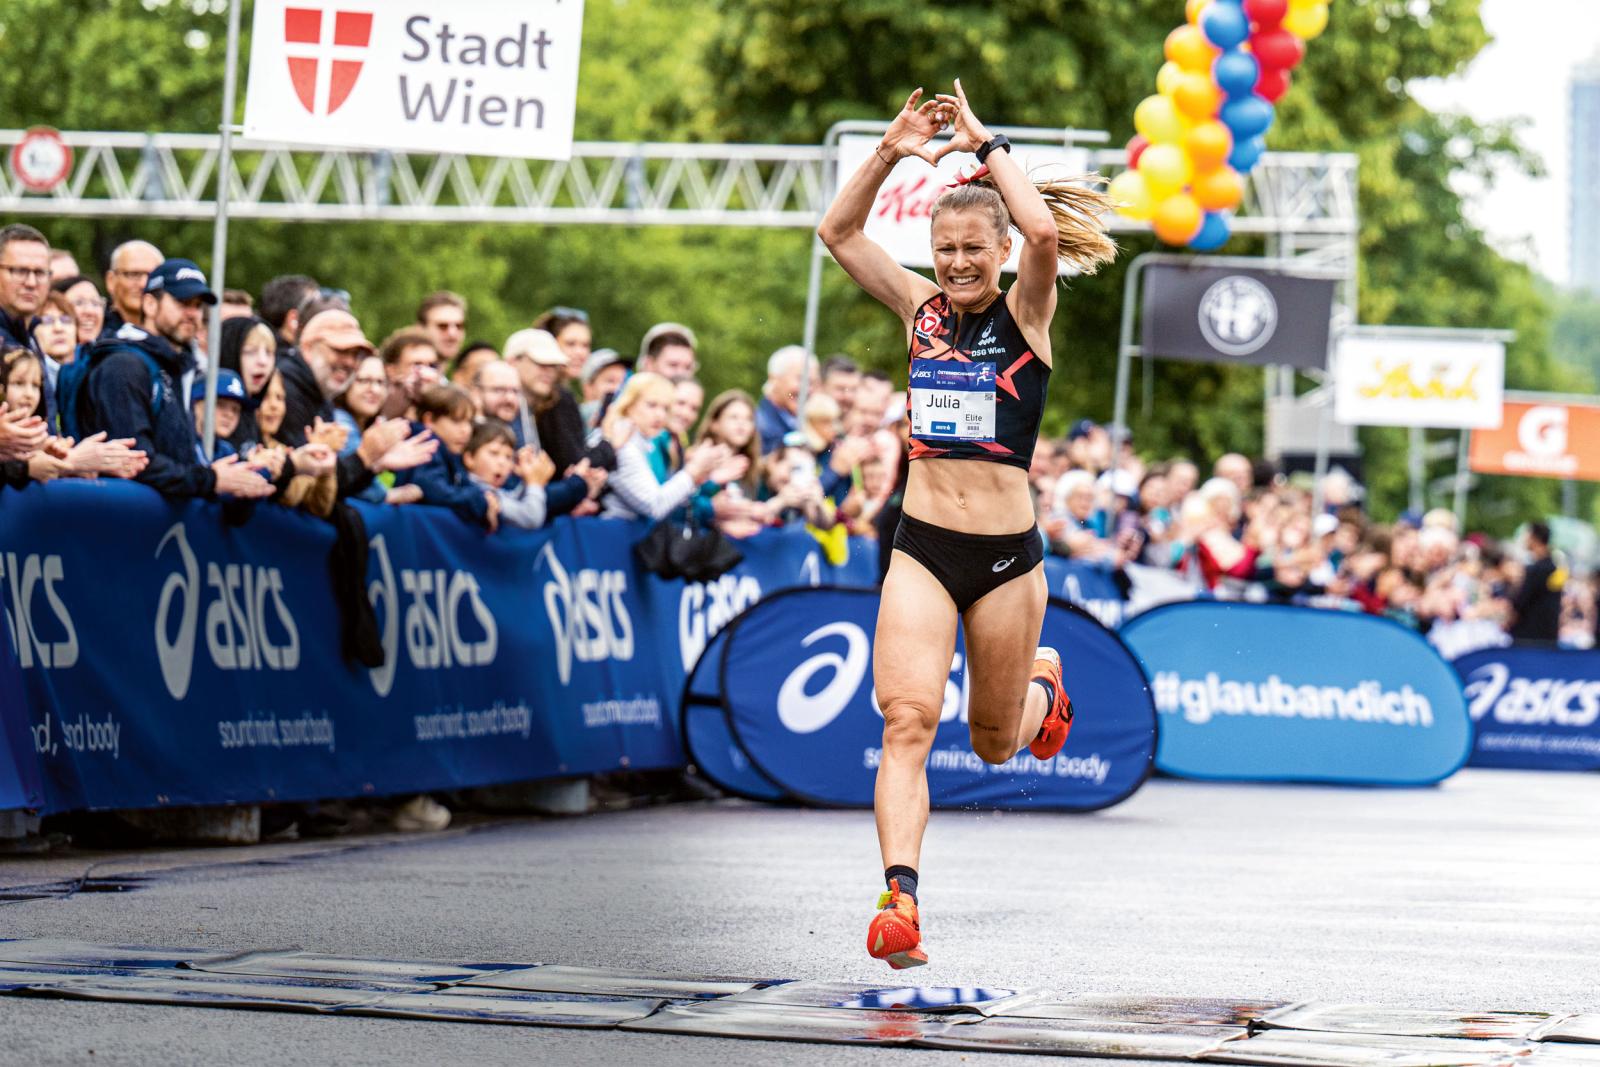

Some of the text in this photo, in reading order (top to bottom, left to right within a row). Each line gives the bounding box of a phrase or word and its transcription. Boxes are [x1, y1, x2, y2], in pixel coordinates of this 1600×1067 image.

[402, 15, 552, 69] Stadt
[399, 75, 544, 129] Wien
[972, 346, 1006, 357] DSG Wien
[926, 394, 960, 409] Julia
[965, 413, 983, 422] Elite
[1517, 406, 1569, 455] G
[205, 561, 301, 670] asics
[1151, 671, 1434, 727] #glaubandich
[1494, 677, 1600, 727] asics
[85, 712, 121, 760] body
[1055, 752, 1112, 785] body
